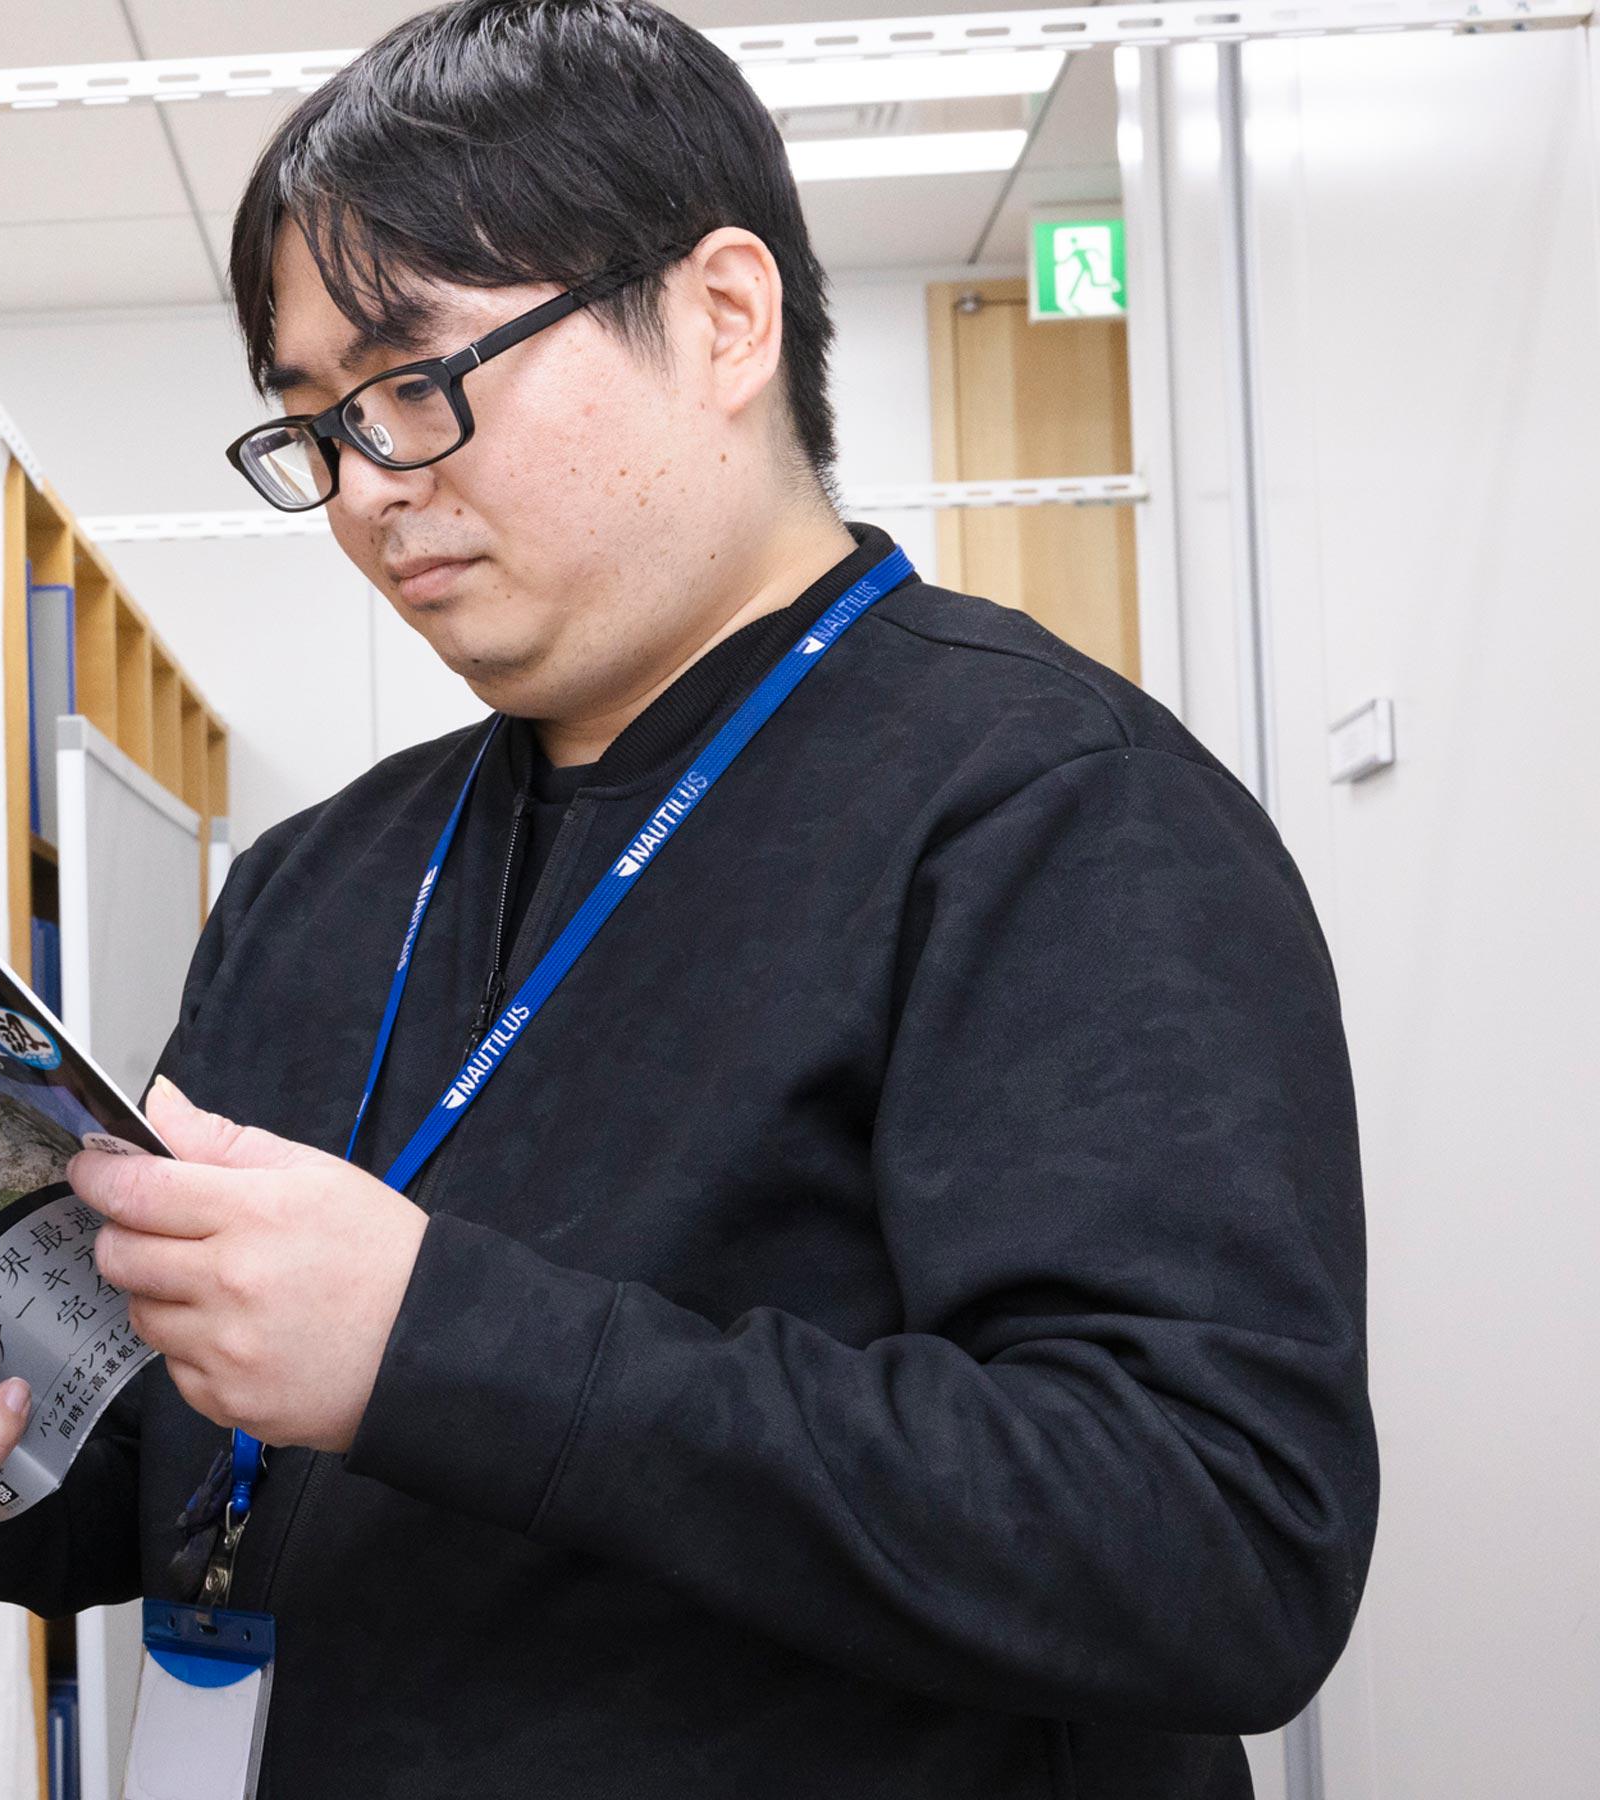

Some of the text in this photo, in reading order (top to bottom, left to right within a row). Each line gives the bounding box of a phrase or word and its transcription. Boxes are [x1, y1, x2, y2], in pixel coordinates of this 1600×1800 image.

[812, 579, 881, 646] NAUTILUS
[628, 769, 710, 867] NAUTILUS
[455, 999, 532, 1098] NAUTILUS
[39, 1320, 131, 1438] バッチとオンライン
